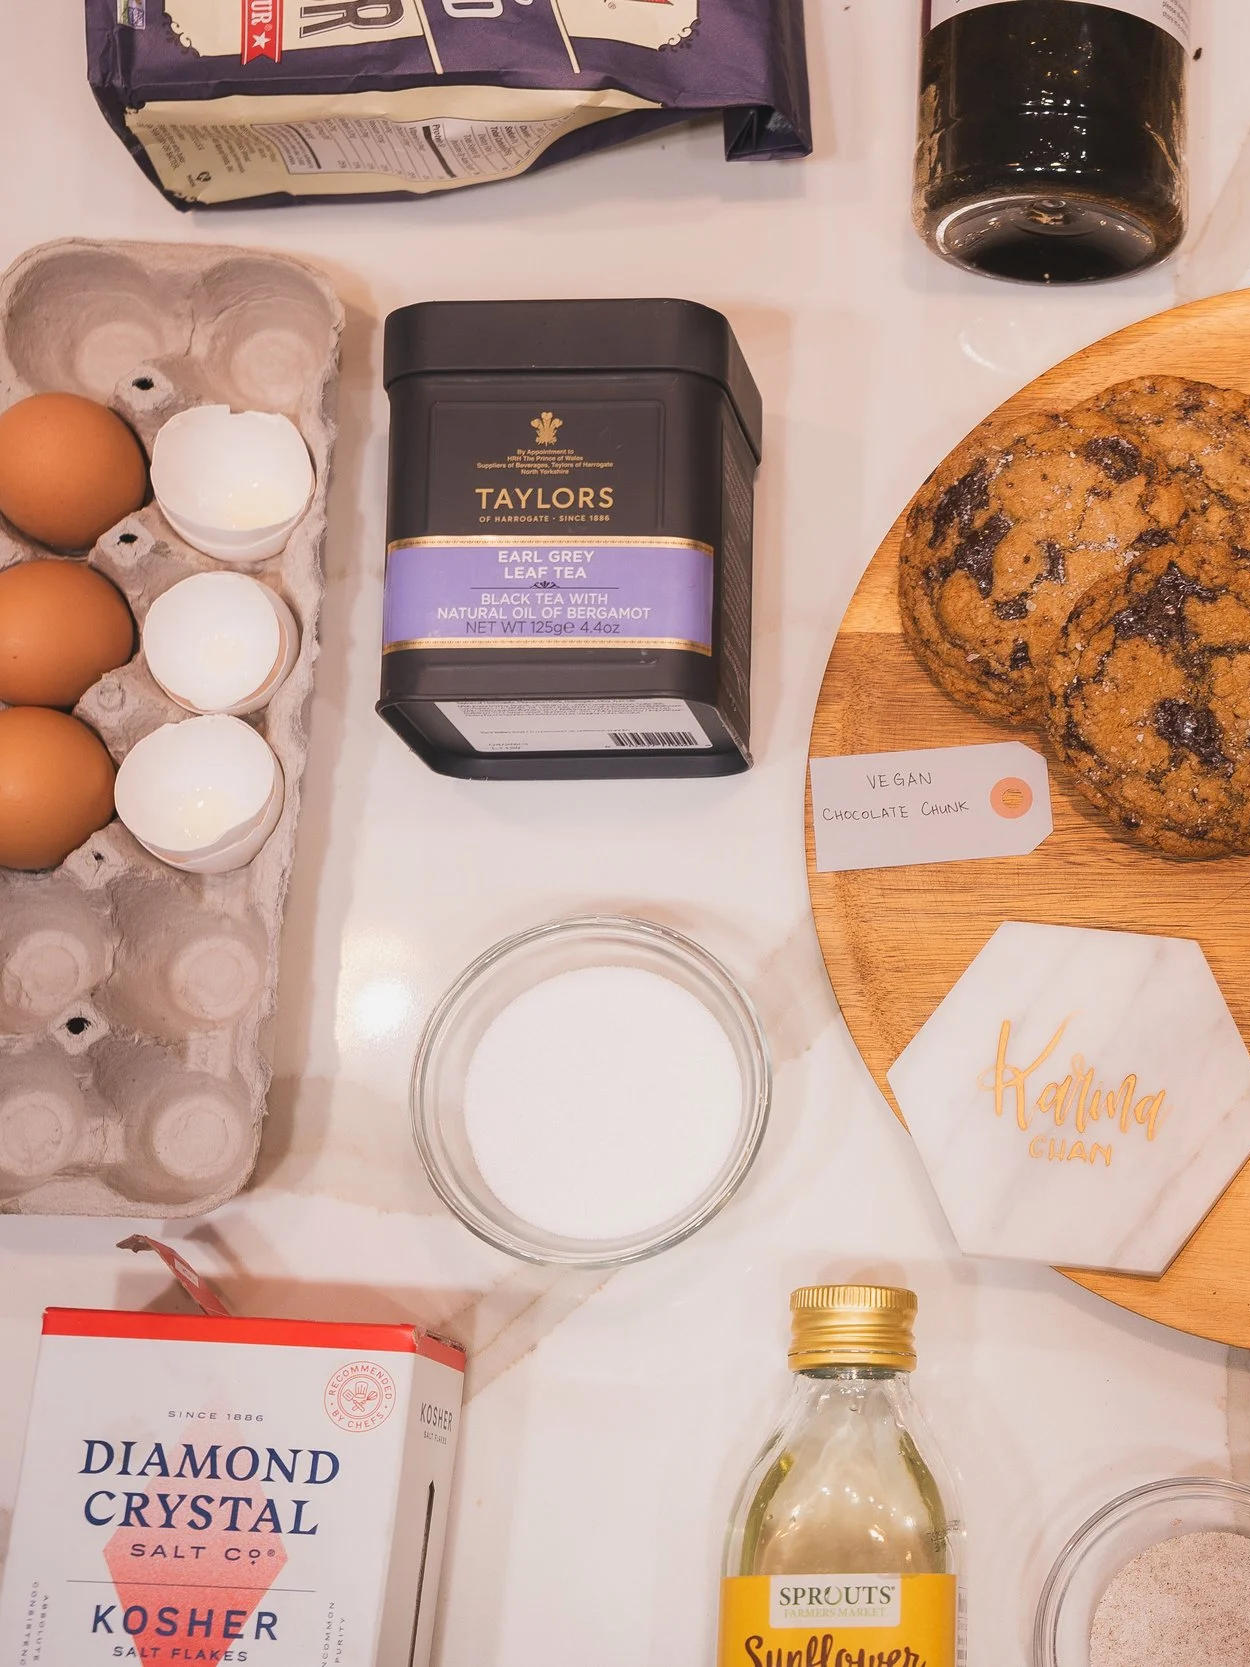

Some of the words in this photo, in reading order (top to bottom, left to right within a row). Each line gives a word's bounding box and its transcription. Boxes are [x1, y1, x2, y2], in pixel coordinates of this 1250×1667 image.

[526, 449, 567, 457] Appointment
[582, 461, 614, 469] Harrogate
[475, 487, 614, 510] TAYLORS
[494, 515, 550, 523] HARROGATE
[498, 550, 543, 563] EARL
[548, 550, 595, 563] GREY
[504, 567, 548, 579] LEAF
[554, 567, 587, 579] TEA
[481, 593, 531, 605] BLACK
[536, 593, 565, 605] TEA
[569, 593, 609, 605] WITH
[437, 607, 508, 619] NATURAL
[512, 607, 537, 619] OIL
[541, 607, 563, 619] OF
[566, 607, 652, 619] BERGAMOT
[466, 621, 497, 634] NET
[501, 621, 526, 633] WT
[580, 620, 621, 634] 4.4oz
[866, 772, 933, 790] VEGAN
[822, 805, 910, 822] CHOCOLATE
[920, 801, 970, 818] CHUNK
[1028, 1134, 1114, 1168] CHAN
[328, 1364, 393, 1400] RECOMMENDED
[168, 1410, 218, 1420] SINCE
[226, 1413, 265, 1422] 1886
[331, 1409, 345, 1423] BY
[346, 1412, 385, 1429] CHEFS
[420, 1402, 453, 1433] KOSHER
[423, 1430, 434, 1441] SALT
[78, 1438, 341, 1485] DIAMOND
[84, 1490, 320, 1536] CRYSTAL
[130, 1543, 207, 1560] SALT
[779, 1586, 892, 1607] SPROUTS
[784, 1608, 837, 1619] FARMERS
[838, 1607, 887, 1618] MARKET
[33, 1593, 50, 1663] ABSOLUTE
[92, 1604, 280, 1642] KOSHER
[334, 1616, 347, 1664] PURITY
[112, 1645, 162, 1660] SALT
[170, 1646, 249, 1663] FLAKES
[744, 1634, 927, 1667] Sunflower
